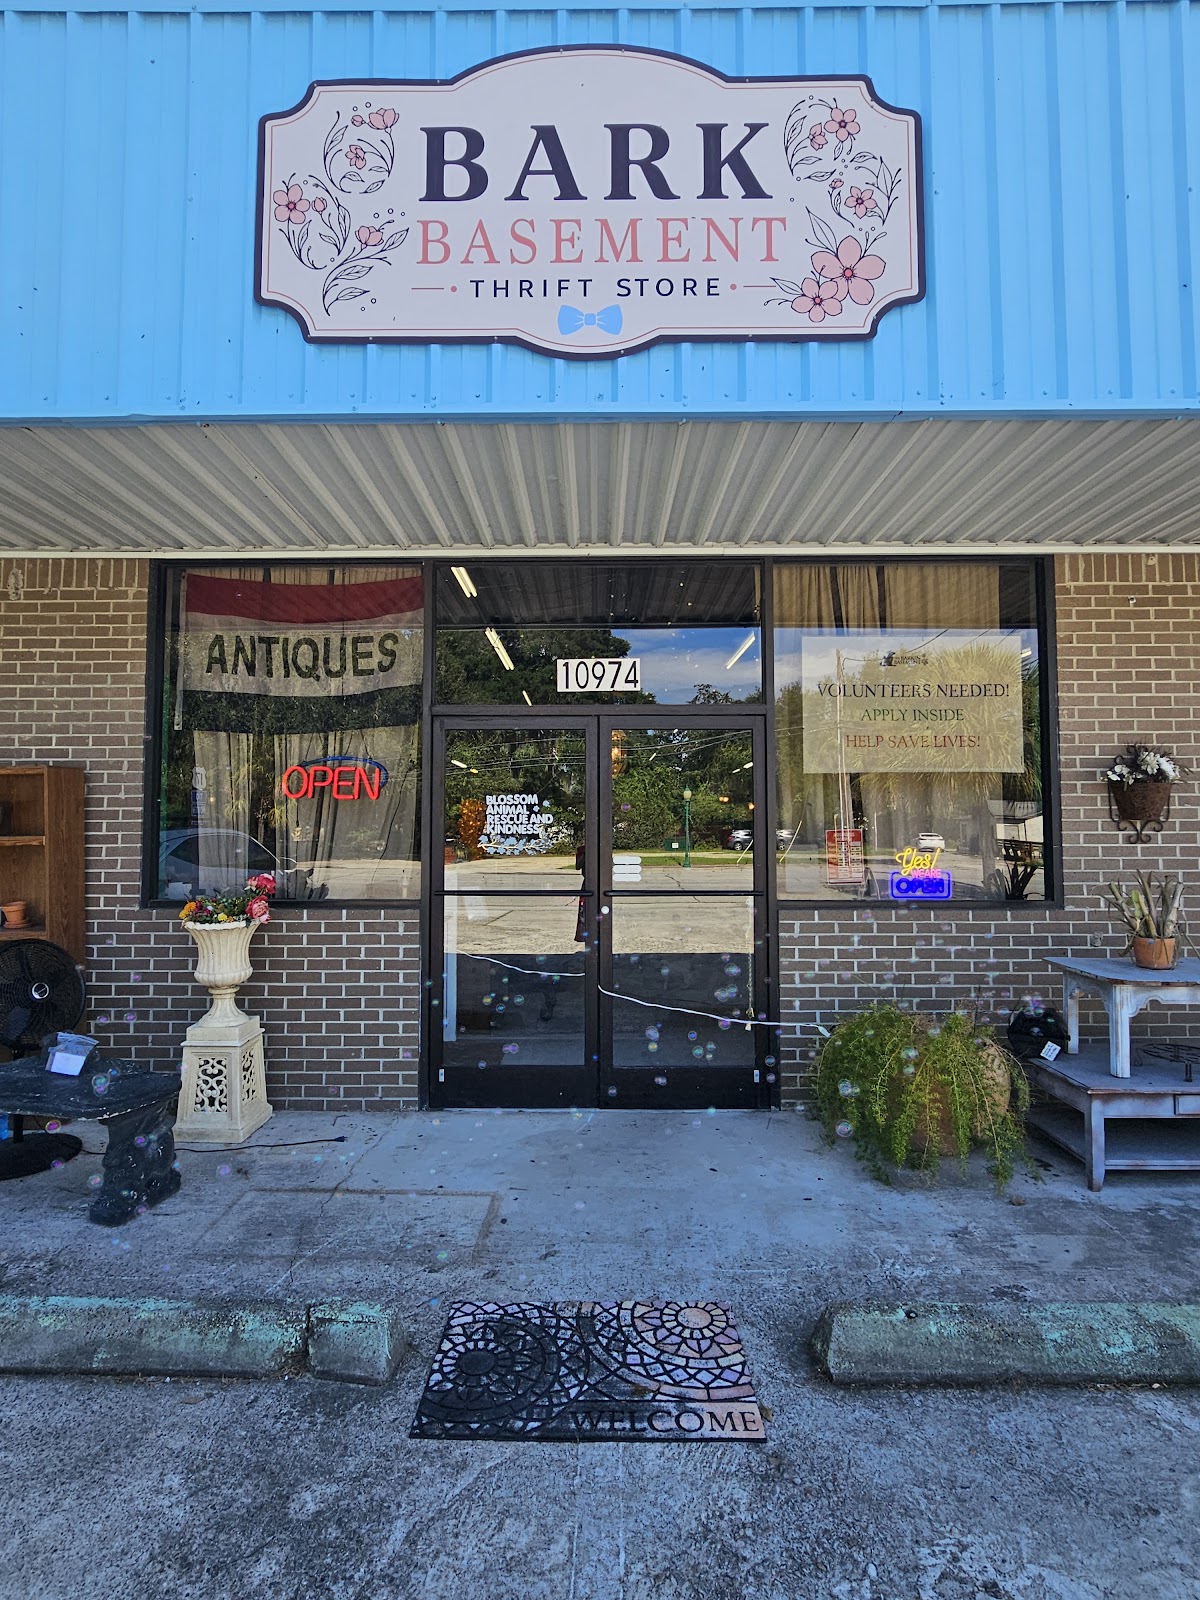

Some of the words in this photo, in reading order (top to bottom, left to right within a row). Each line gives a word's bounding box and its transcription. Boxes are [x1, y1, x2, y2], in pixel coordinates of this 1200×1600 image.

[418, 122, 774, 202] BARK
[416, 216, 787, 265] BASEMENT
[469, 278, 594, 299] THRIFT
[616, 277, 720, 298] STORE
[205, 632, 399, 682] ANTIQUES
[562, 660, 639, 689] 10974
[817, 683, 931, 698] VOLUNTEERS
[936, 683, 1010, 698] NEEDED!
[861, 708, 908, 722] APPLY
[913, 708, 965, 722] INSIDE
[846, 735, 884, 748] HELP
[888, 735, 930, 748] SAVE
[934, 735, 980, 748] LIVES!
[282, 765, 381, 800] OPEN
[486, 794, 539, 805] BLOSSOM
[486, 804, 529, 815] ANIMAL
[487, 814, 529, 825] RESCUE
[529, 813, 554, 824] AND
[486, 824, 540, 835] KINDNESS
[895, 847, 941, 876] Yes!
[896, 877, 945, 894] OPEN
[569, 1410, 760, 1433] WELCOME
